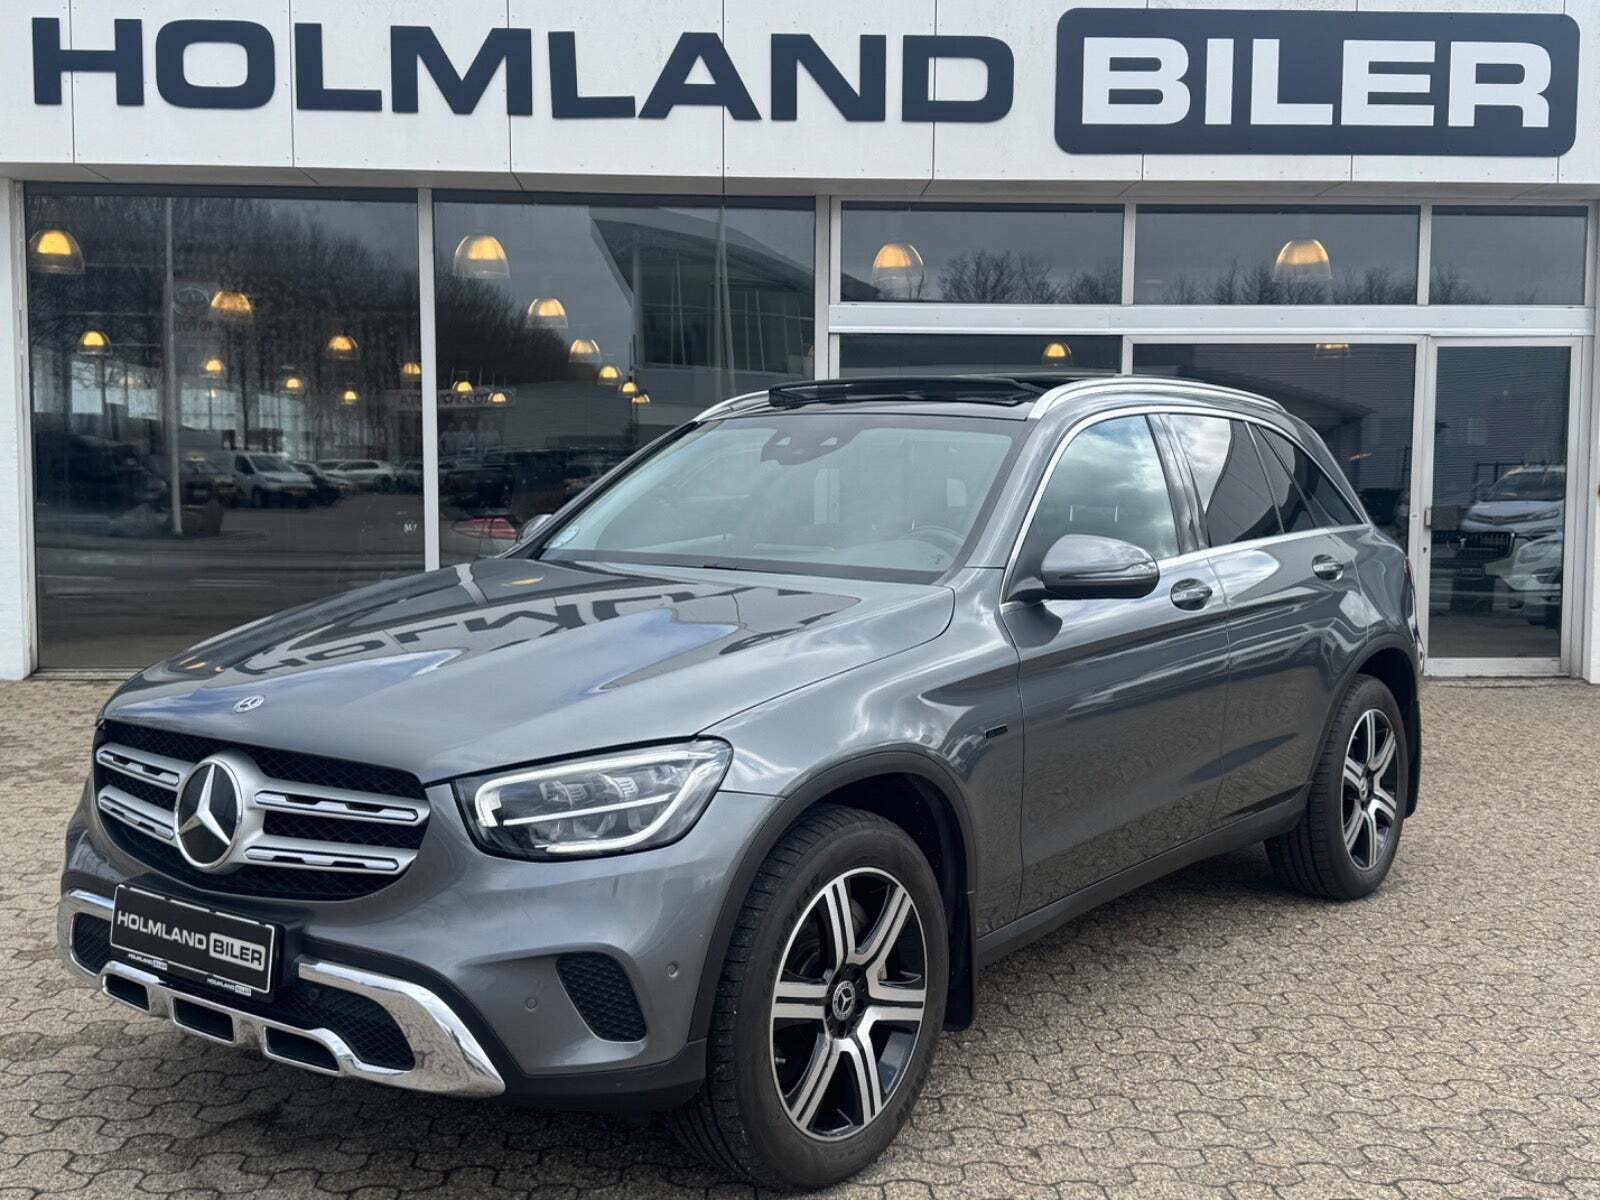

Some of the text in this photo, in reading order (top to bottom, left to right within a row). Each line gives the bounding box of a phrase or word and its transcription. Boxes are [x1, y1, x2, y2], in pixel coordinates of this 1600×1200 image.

[32, 18, 1551, 127] HOLMLAND BILER
[117, 910, 263, 967] HOLMLAND BILER
